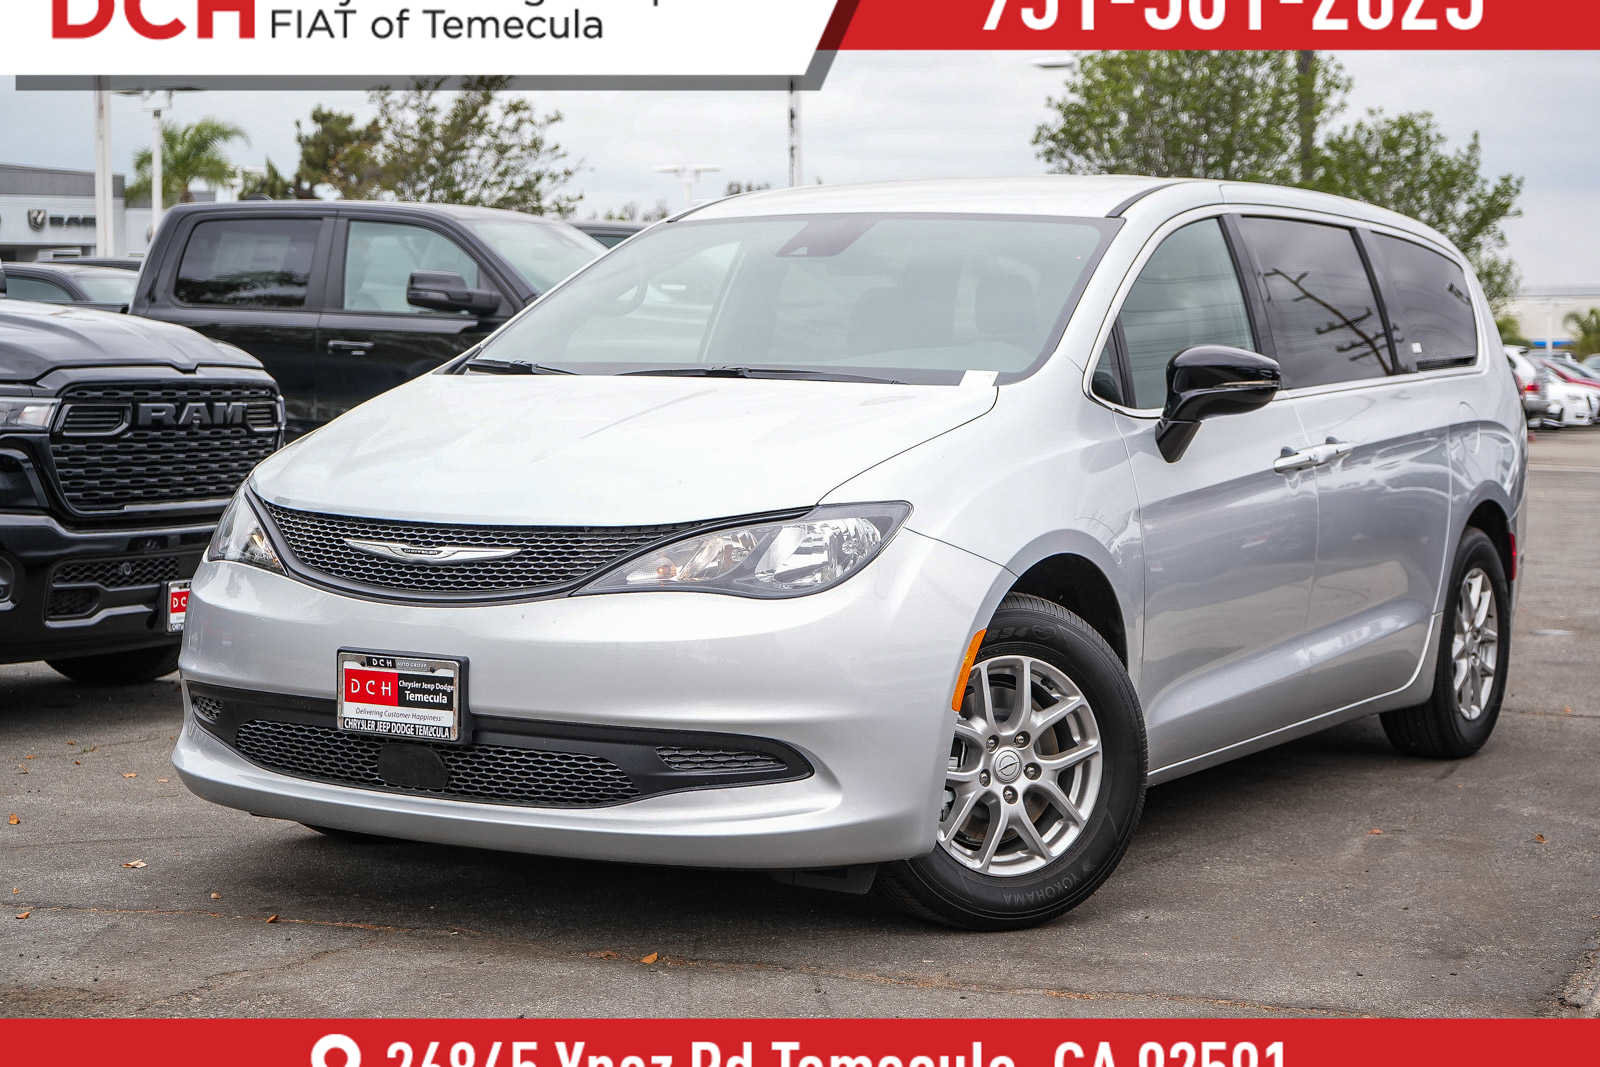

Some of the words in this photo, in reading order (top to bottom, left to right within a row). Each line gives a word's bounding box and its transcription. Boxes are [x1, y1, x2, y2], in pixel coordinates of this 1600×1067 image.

[137, 401, 247, 425] RAM
[372, 657, 393, 667] DCH
[351, 678, 392, 697] DCH
[398, 679, 421, 690] Chrysler
[422, 681, 435, 691] Jeep
[435, 682, 454, 693] Dodge
[404, 690, 448, 704] Temecula
[355, 706, 383, 717] Delivering
[384, 710, 411, 719] Customer
[344, 718, 376, 732] CHRYSLER
[376, 720, 390, 733] JEEP
[391, 722, 415, 736] DODGE
[415, 724, 450, 739] TEMECULA
